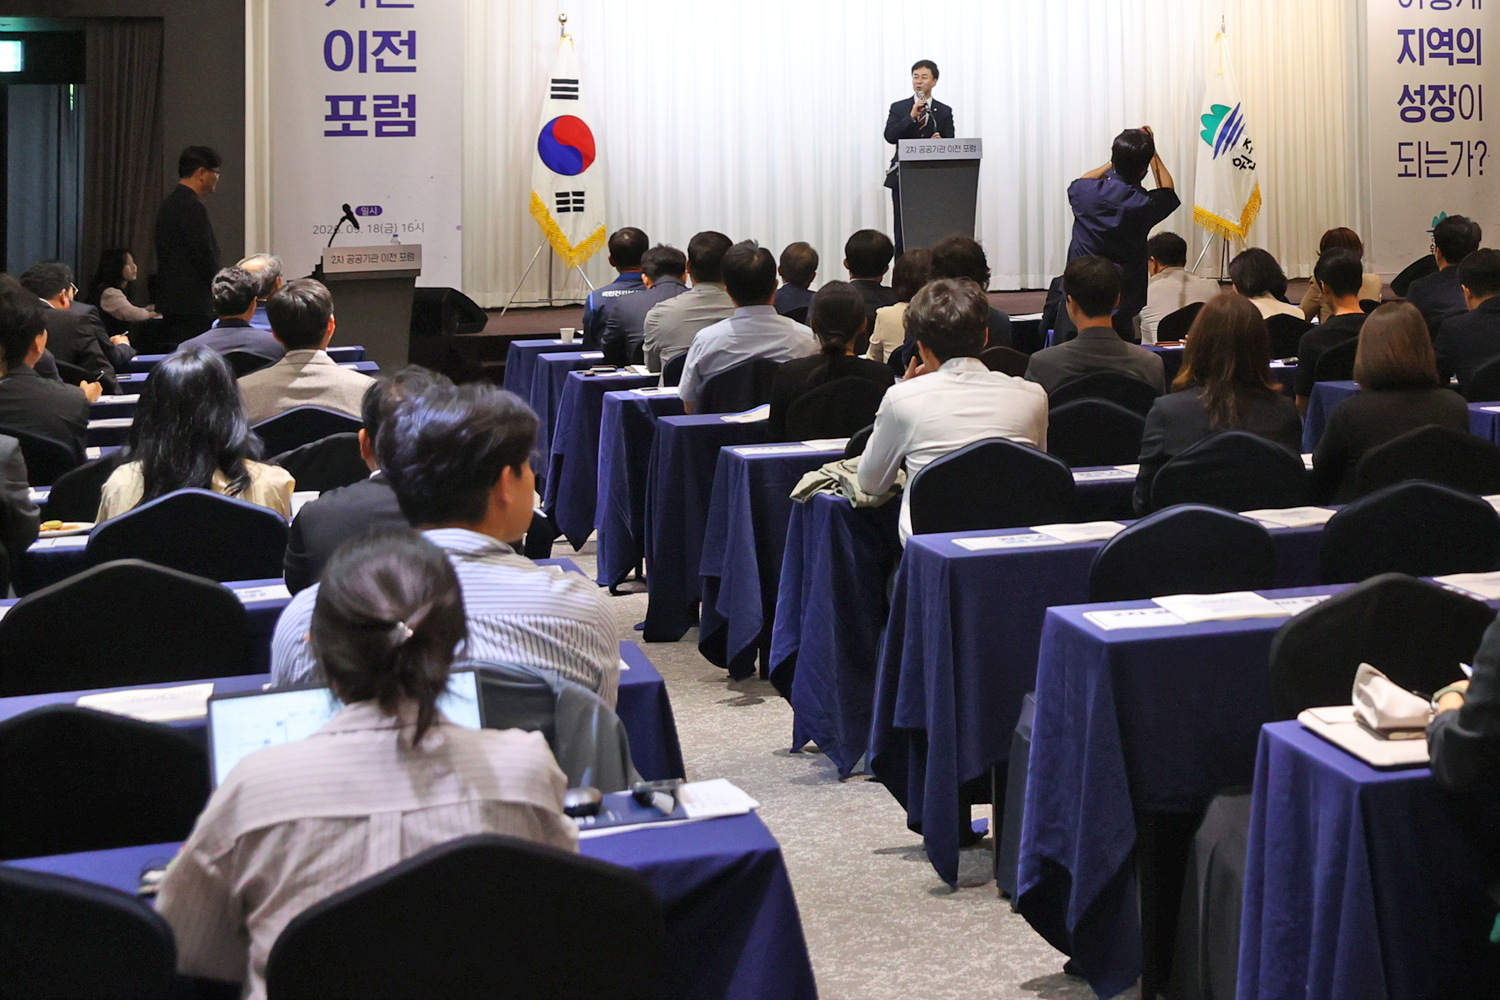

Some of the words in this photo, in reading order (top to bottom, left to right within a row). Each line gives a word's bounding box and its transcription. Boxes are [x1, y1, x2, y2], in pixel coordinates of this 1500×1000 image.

[323, 29, 418, 74] 이전
[1396, 27, 1482, 67] 지역의
[323, 94, 417, 138] 포럼
[1397, 83, 1483, 124] 성장이
[906, 146, 917, 154] 2차
[919, 145, 946, 153] 공공기관
[948, 145, 961, 153] 이전
[963, 144, 976, 153] 포럼
[1397, 140, 1488, 179] 되는가?
[361, 206, 378, 216] 일시
[367, 223, 398, 234] 18(금)
[401, 222, 425, 233] 16시
[331, 255, 344, 264] 2차
[347, 253, 379, 264] 공공기관
[381, 253, 397, 263] 이전
[399, 252, 415, 262] 포럼
